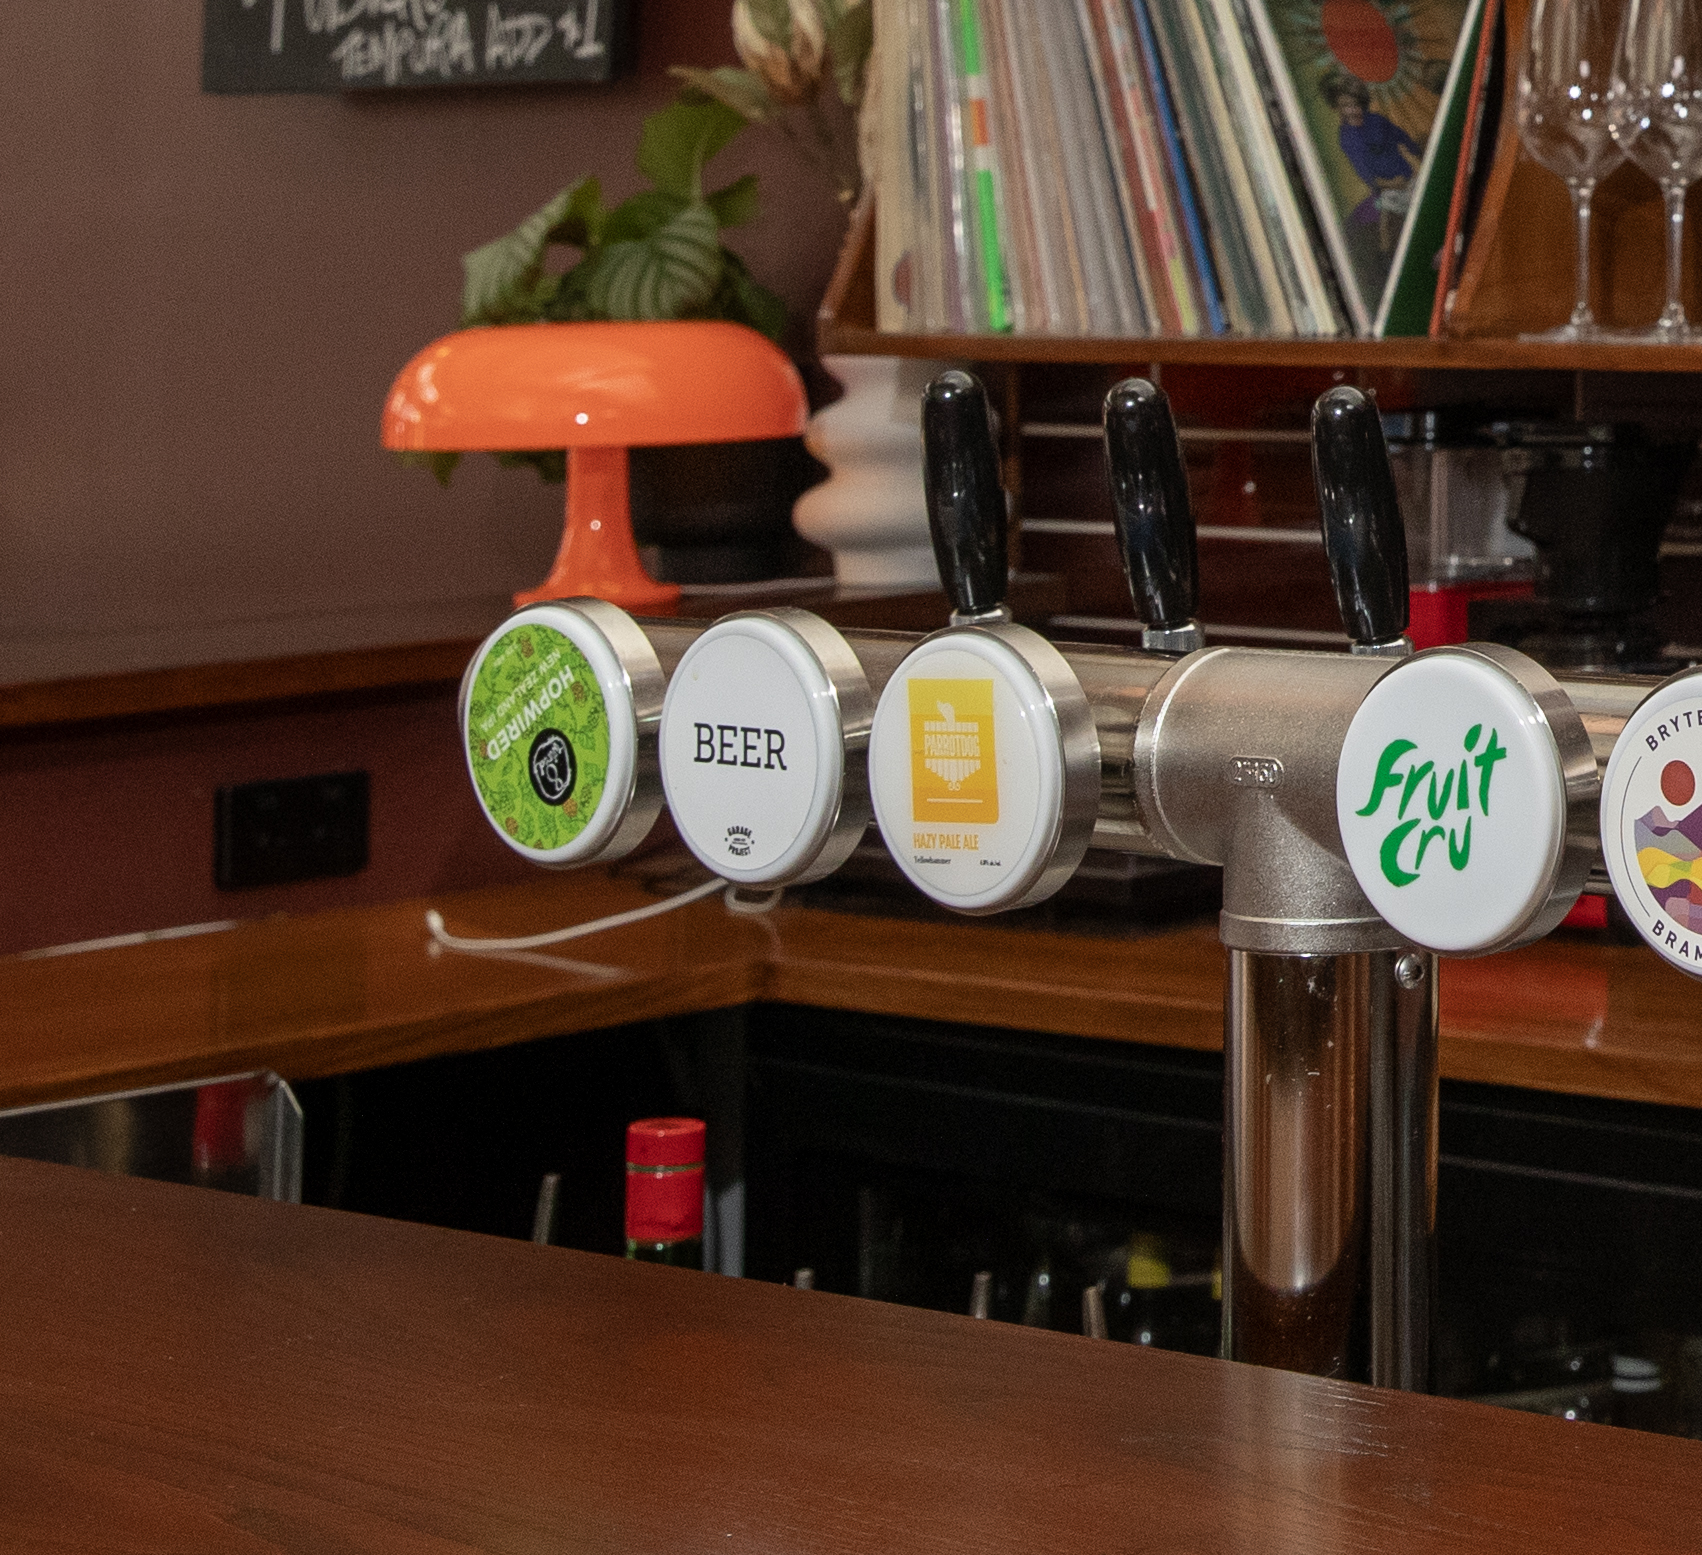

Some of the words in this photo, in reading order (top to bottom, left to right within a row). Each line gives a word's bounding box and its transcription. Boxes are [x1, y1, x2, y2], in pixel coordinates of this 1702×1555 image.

[329, 8, 474, 87] TEMPURA
[484, 2, 553, 69] ADD
[537, 648, 562, 676] NEW
[486, 664, 575, 761] HOPWIRED
[496, 671, 540, 717] ZEALAND
[693, 722, 788, 771] BEER
[924, 734, 980, 757] PARROTDOG
[1355, 723, 1507, 819] Fruit
[912, 832, 937, 851] HAZY
[938, 833, 961, 850] PALE
[962, 834, 980, 851] ALE
[1379, 815, 1473, 887] Cru
